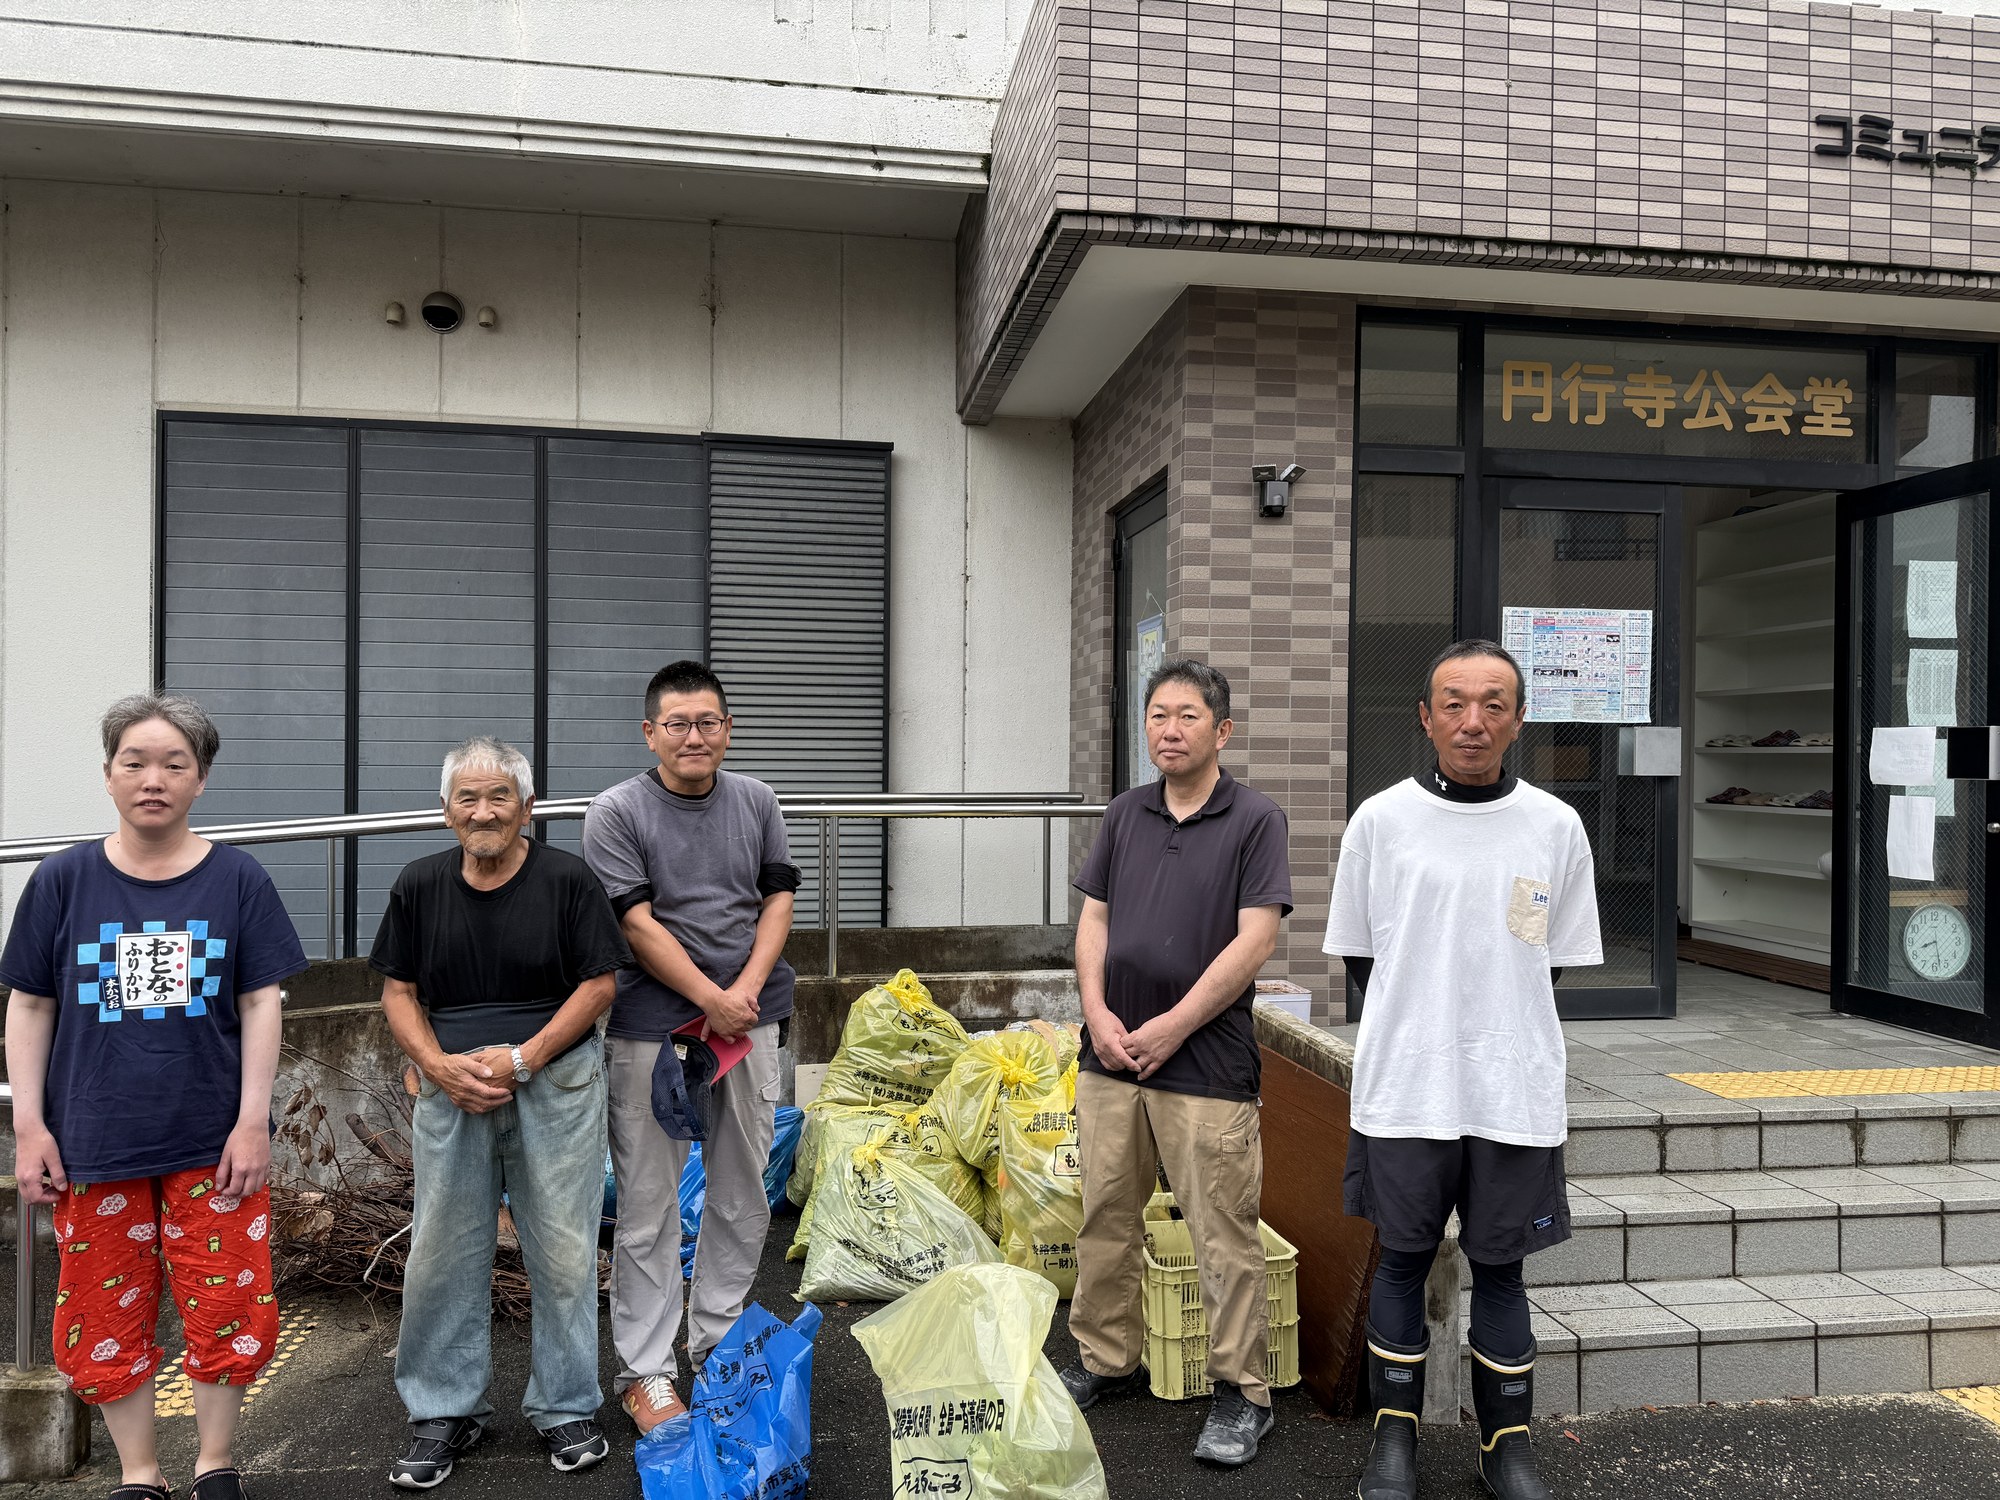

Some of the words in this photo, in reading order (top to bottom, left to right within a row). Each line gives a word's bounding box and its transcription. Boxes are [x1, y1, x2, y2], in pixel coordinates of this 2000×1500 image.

[1502, 360, 1853, 437] 円行寺公会堂
[1534, 892, 1548, 904] Lee
[1920, 915, 1927, 924] 11
[1930, 911, 1939, 921] 12
[1944, 915, 1948, 924] 1
[1911, 924, 1919, 934] 10
[1951, 923, 1957, 933] 2
[1908, 937, 1914, 947] 9
[1955, 937, 1961, 946] 3
[1912, 950, 1918, 960] 8
[1951, 950, 1957, 959] 4
[1920, 960, 1926, 969] 7
[1932, 963, 1938, 972] 6
[1943, 960, 1949, 969] 5
[125, 942, 143, 1001] ふりかけ
[145, 938, 179, 1002] おとなの
[104, 978, 121, 1009] 本かつお
